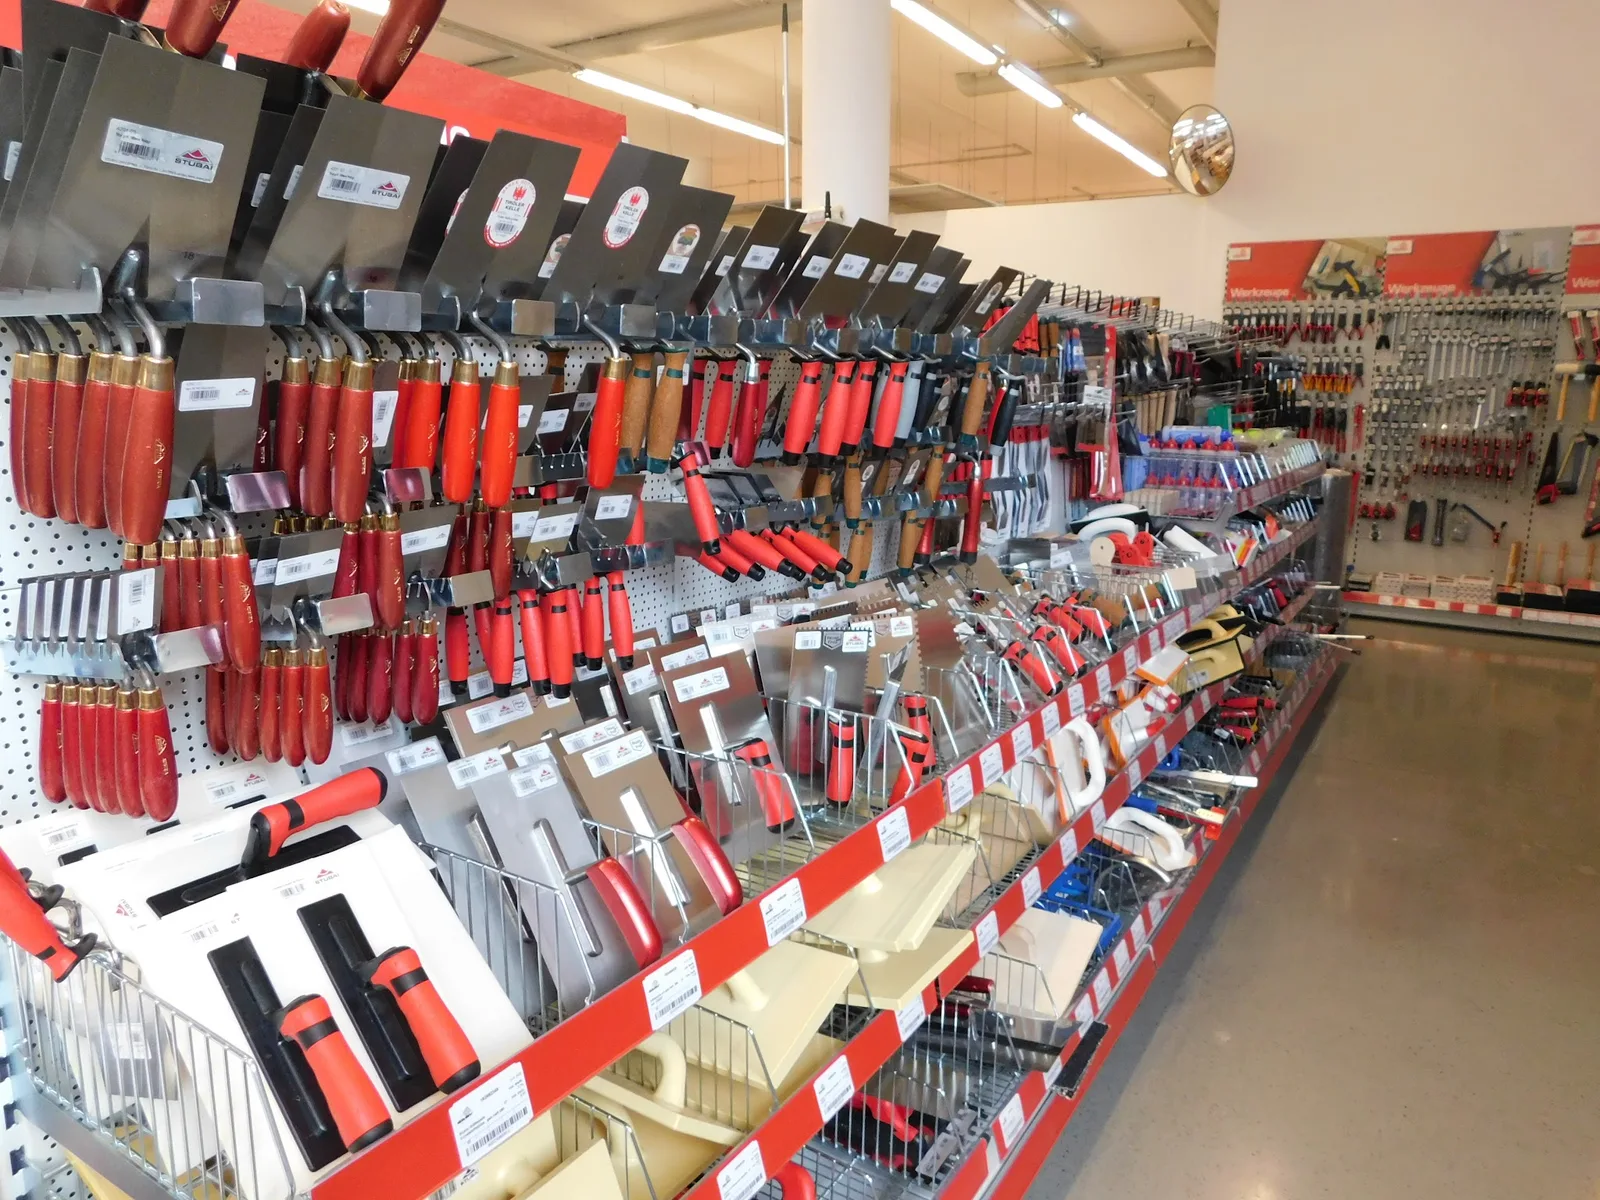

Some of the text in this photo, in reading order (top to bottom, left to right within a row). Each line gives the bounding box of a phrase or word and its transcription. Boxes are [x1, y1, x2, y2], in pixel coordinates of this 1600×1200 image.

[175, 158, 213, 170] STUBAI
[372, 190, 400, 198] STUBAI
[1229, 288, 1290, 298] Werkzeuge
[244, 778, 265, 787] STUBAI
[314, 873, 340, 884] STUBAI
